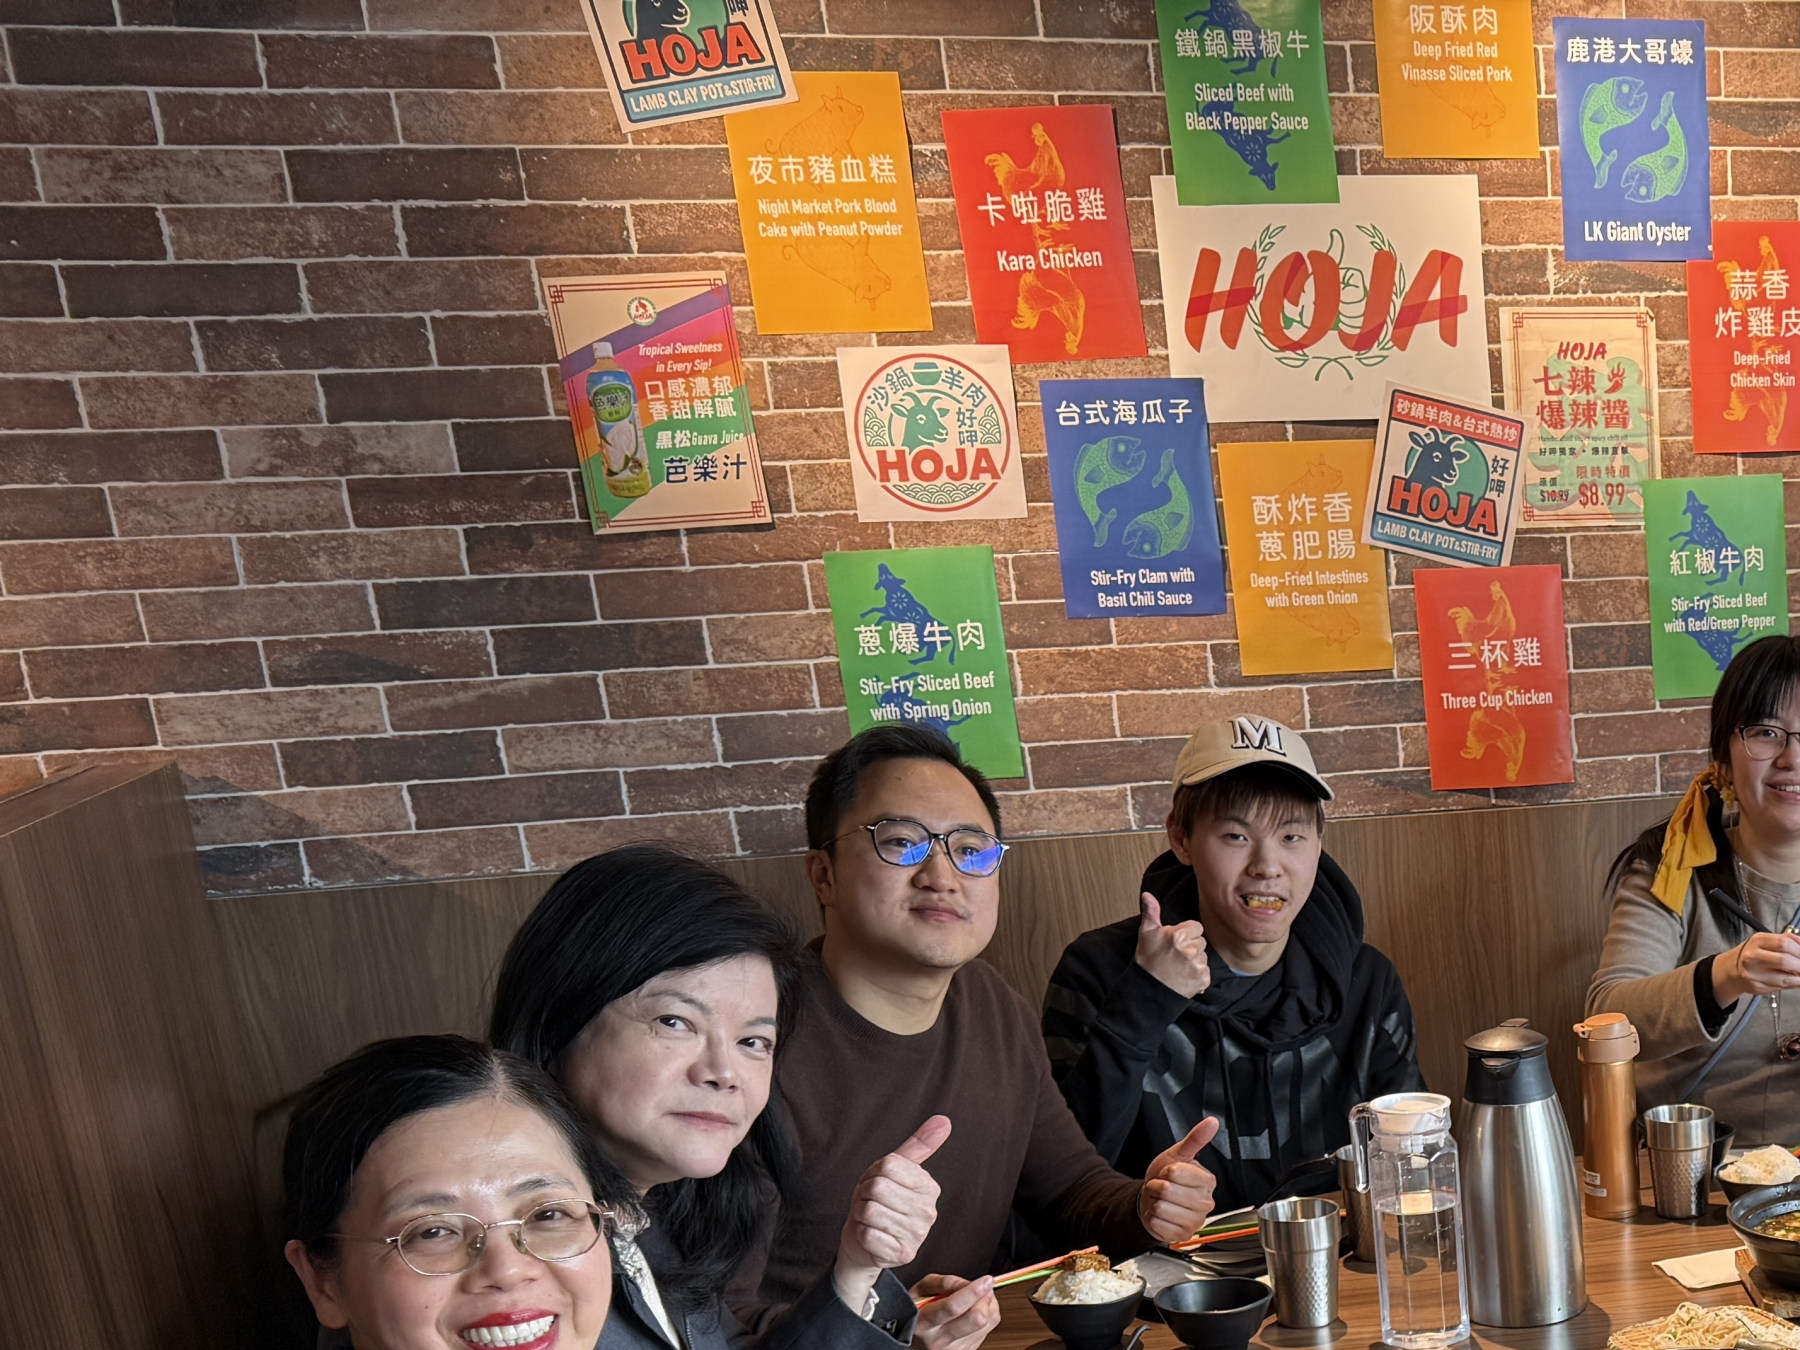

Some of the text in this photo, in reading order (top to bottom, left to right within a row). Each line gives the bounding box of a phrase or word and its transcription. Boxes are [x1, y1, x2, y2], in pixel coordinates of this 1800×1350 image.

[1409, 5, 1498, 35] 阪酥肉
[620, 22, 765, 83] HOJA
[1174, 28, 1310, 59] 鐵鍋黑椒牛
[1413, 41, 1498, 61] Deep Fried Red
[1566, 36, 1694, 66] 鹿港大哥蠔
[1401, 63, 1513, 82] Vinasse Sliced Pork
[630, 92, 667, 113] LAMB
[668, 87, 698, 107] CLAY
[1194, 83, 1294, 102] Sliced Beef with
[1185, 112, 1309, 135] Black Pepper Sauce
[747, 154, 897, 185] 夜市豬血糕
[758, 198, 897, 218] Night Market Pork Blood
[977, 187, 1107, 227] 卡啦脆雞
[758, 220, 903, 237] Cake with Peanut Powder
[1584, 221, 1691, 246] LK Giant Oyster
[997, 247, 1103, 272] Kara Chicken
[1729, 268, 1790, 301] 蒜香
[1185, 247, 1468, 353] HOJA
[638, 342, 723, 358] Tropical Sweetness
[1556, 341, 1608, 361] HOJA
[1733, 350, 1791, 368] Deep-Fried
[656, 359, 712, 374] in Every Sip!
[644, 375, 734, 399] 口感濃郁
[1533, 365, 1597, 397] 七辣
[1730, 372, 1796, 388] Chicken Skin
[648, 397, 737, 421] 香甜解膩
[1056, 399, 1193, 426] 台式海瓜子
[1536, 399, 1631, 431] 爆辣醬
[656, 430, 745, 449] 黑松 Guava Juice
[664, 453, 748, 484] 芭樂汁
[875, 448, 1002, 482] HOJA
[1387, 475, 1499, 537] HOJA
[1578, 481, 1625, 509] $8.99
[1251, 492, 1352, 526] 酥炸香
[1377, 519, 1407, 538] LAMB
[1409, 527, 1435, 545] CLAY
[1255, 528, 1356, 562] 蔥肥腸
[1669, 545, 1765, 576] 紅椒牛肉
[1090, 568, 1195, 588] Stir-Fry Clam with
[1250, 569, 1369, 590] Deep-Fried Intestines
[1098, 591, 1193, 608] Basil Chili Sauce
[1265, 589, 1358, 608] with Green Onion
[1671, 592, 1768, 613] Stir-Fry Sliced Beef
[1664, 614, 1776, 633] with Red/Green Pepper
[854, 619, 986, 656] 蔥爆牛肉
[1448, 637, 1542, 669] 三杯雞
[859, 671, 995, 697] Stir-Fry Sliced Beef
[870, 698, 992, 722] with Spring Onion
[1441, 689, 1553, 711] Three Cup Chicken
